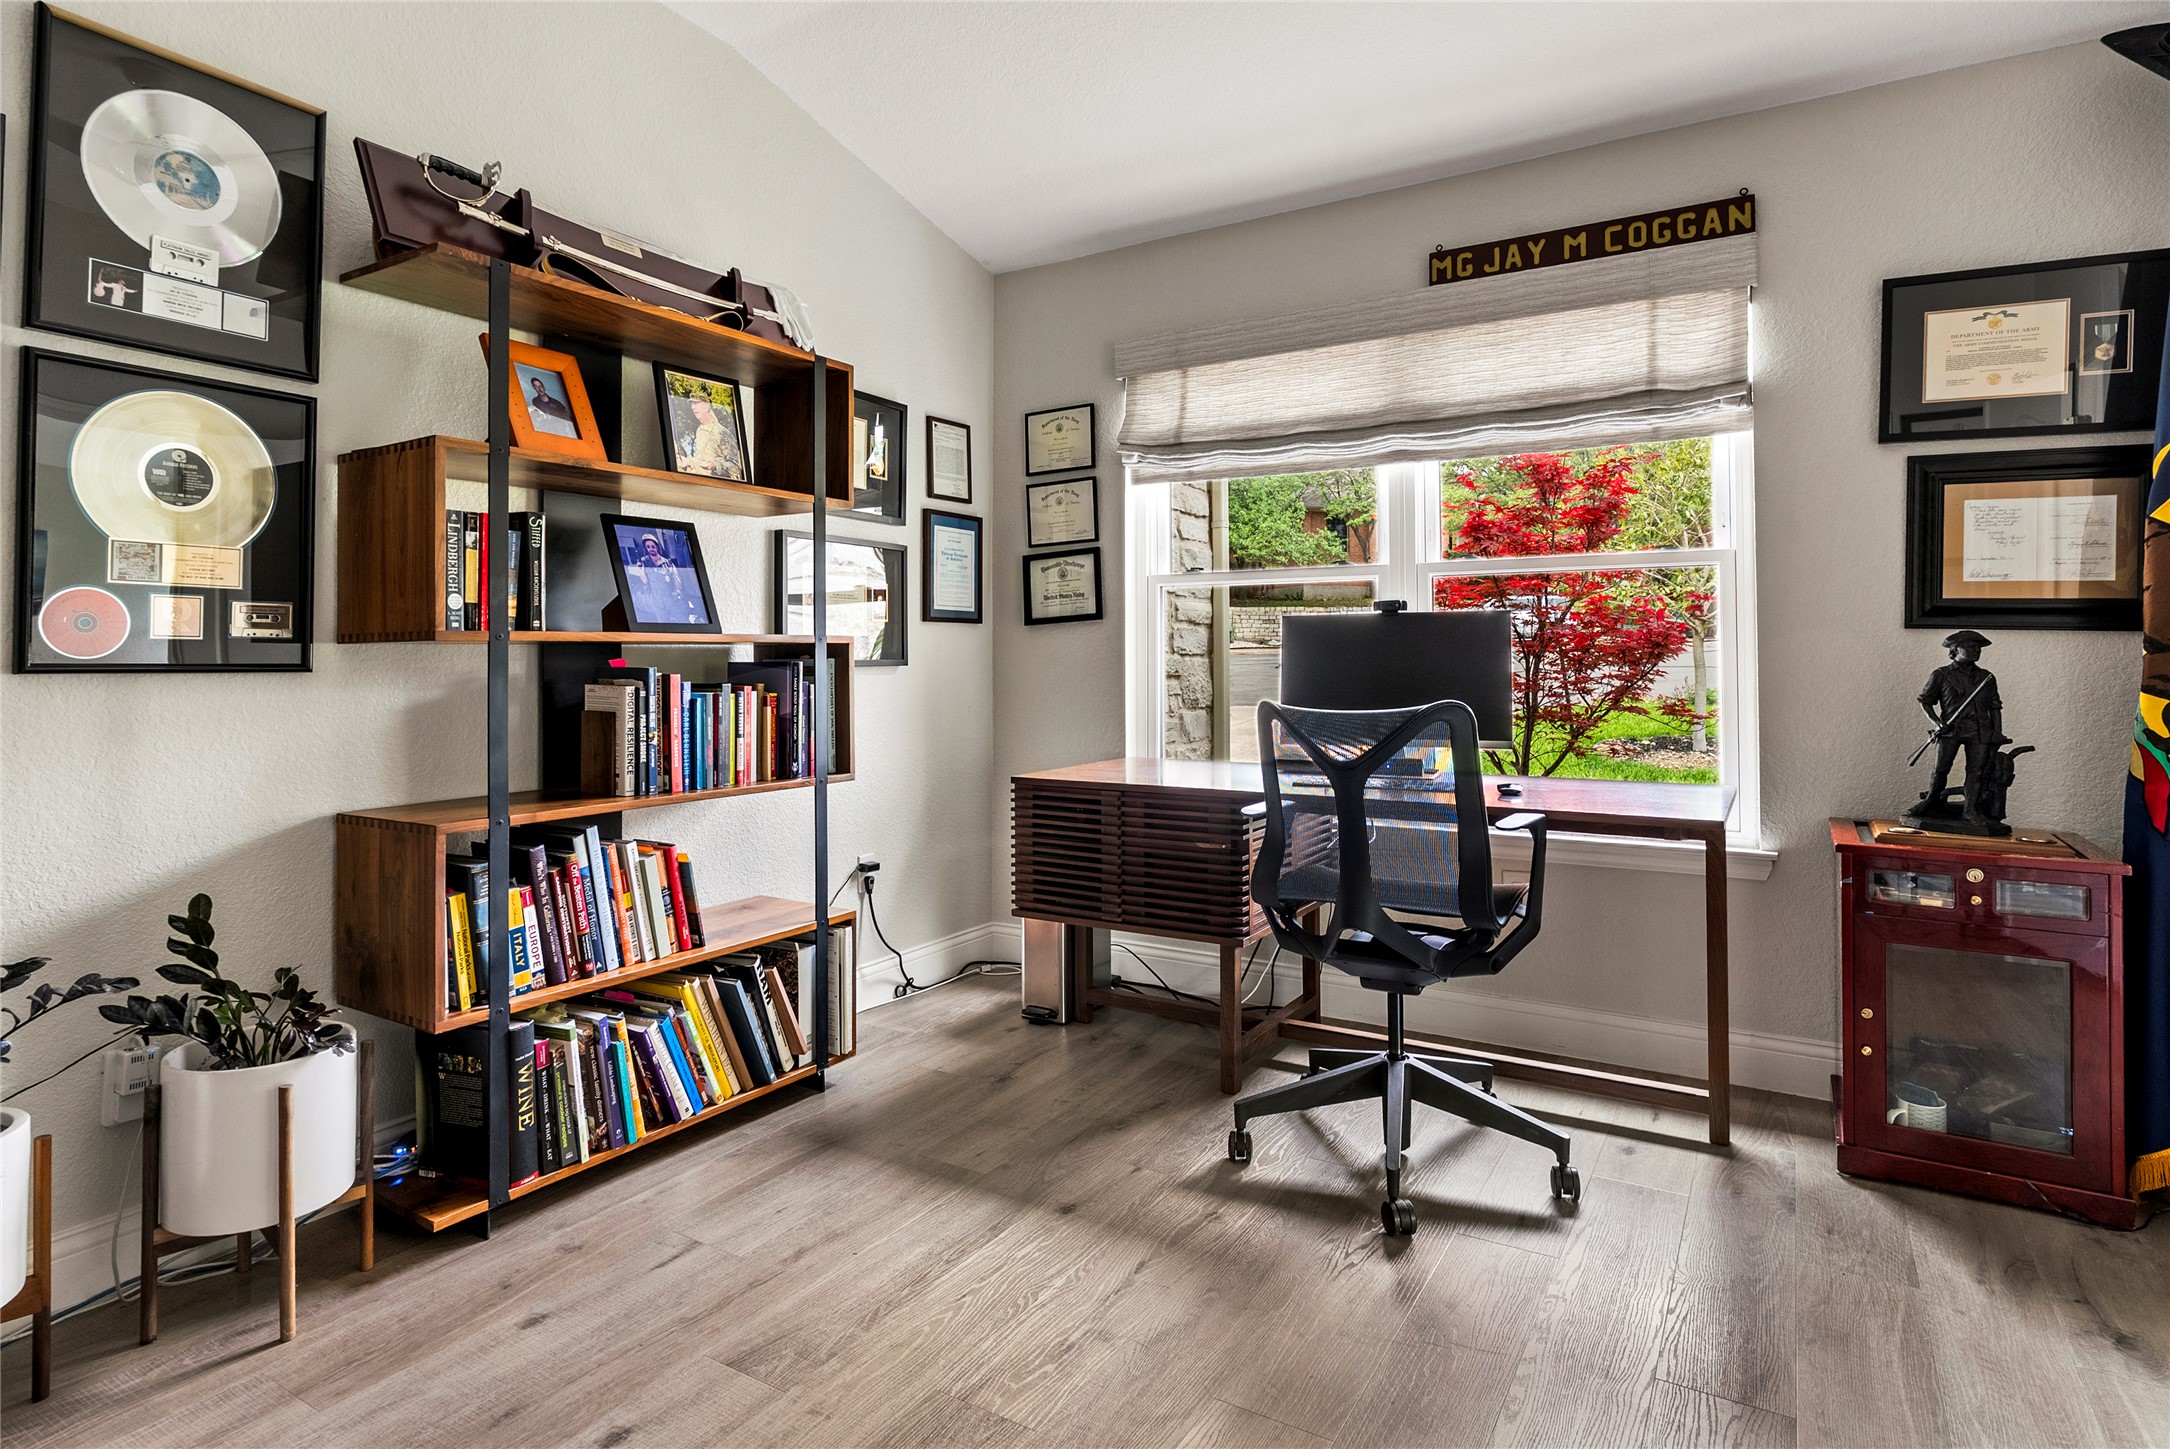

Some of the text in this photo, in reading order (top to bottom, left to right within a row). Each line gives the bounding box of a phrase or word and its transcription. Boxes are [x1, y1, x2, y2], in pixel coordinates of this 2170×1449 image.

[163, 242, 183, 250] PLATINUM
[1432, 202, 1752, 282] MG JAY M COGGAN
[1951, 330, 1994, 339] DEPARTMENT
[1041, 417, 1059, 429] Department
[1071, 416, 1080, 424] Navy
[1041, 490, 1059, 501] Department
[1071, 490, 1080, 498] Navy
[529, 517, 542, 548] STIFFED
[448, 523, 460, 591] LINDBERGH
[1040, 560, 1085, 574] Honorable Discharge
[1059, 591, 1072, 599] States
[537, 861, 545, 880] Who's
[571, 865, 579, 877] Off
[542, 896, 549, 904] In
[574, 884, 583, 910] Beaten
[583, 878, 598, 940] Medal of Honor
[593, 849, 603, 886] HEARST'S
[602, 906, 611, 938] SIMEON
[543, 905, 554, 932] California
[555, 876, 563, 907] CAMPING
[560, 908, 571, 955] DESTINATIONS
[561, 894, 571, 933] SOUTHWEST
[578, 911, 587, 929] Path
[462, 929, 470, 954] National
[513, 933, 525, 966] ITALY
[528, 925, 541, 968] EUROPE
[756, 964, 771, 1005] NAM
[686, 1016, 698, 1036] VEGAN
[696, 1039, 704, 1052] FOR
[694, 1009, 706, 1036] UNIVERSITY
[707, 1044, 720, 1072] BRIDGEPORT
[700, 999, 735, 1077] WISTARIAN 1973
[518, 1060, 534, 1131] WINE
